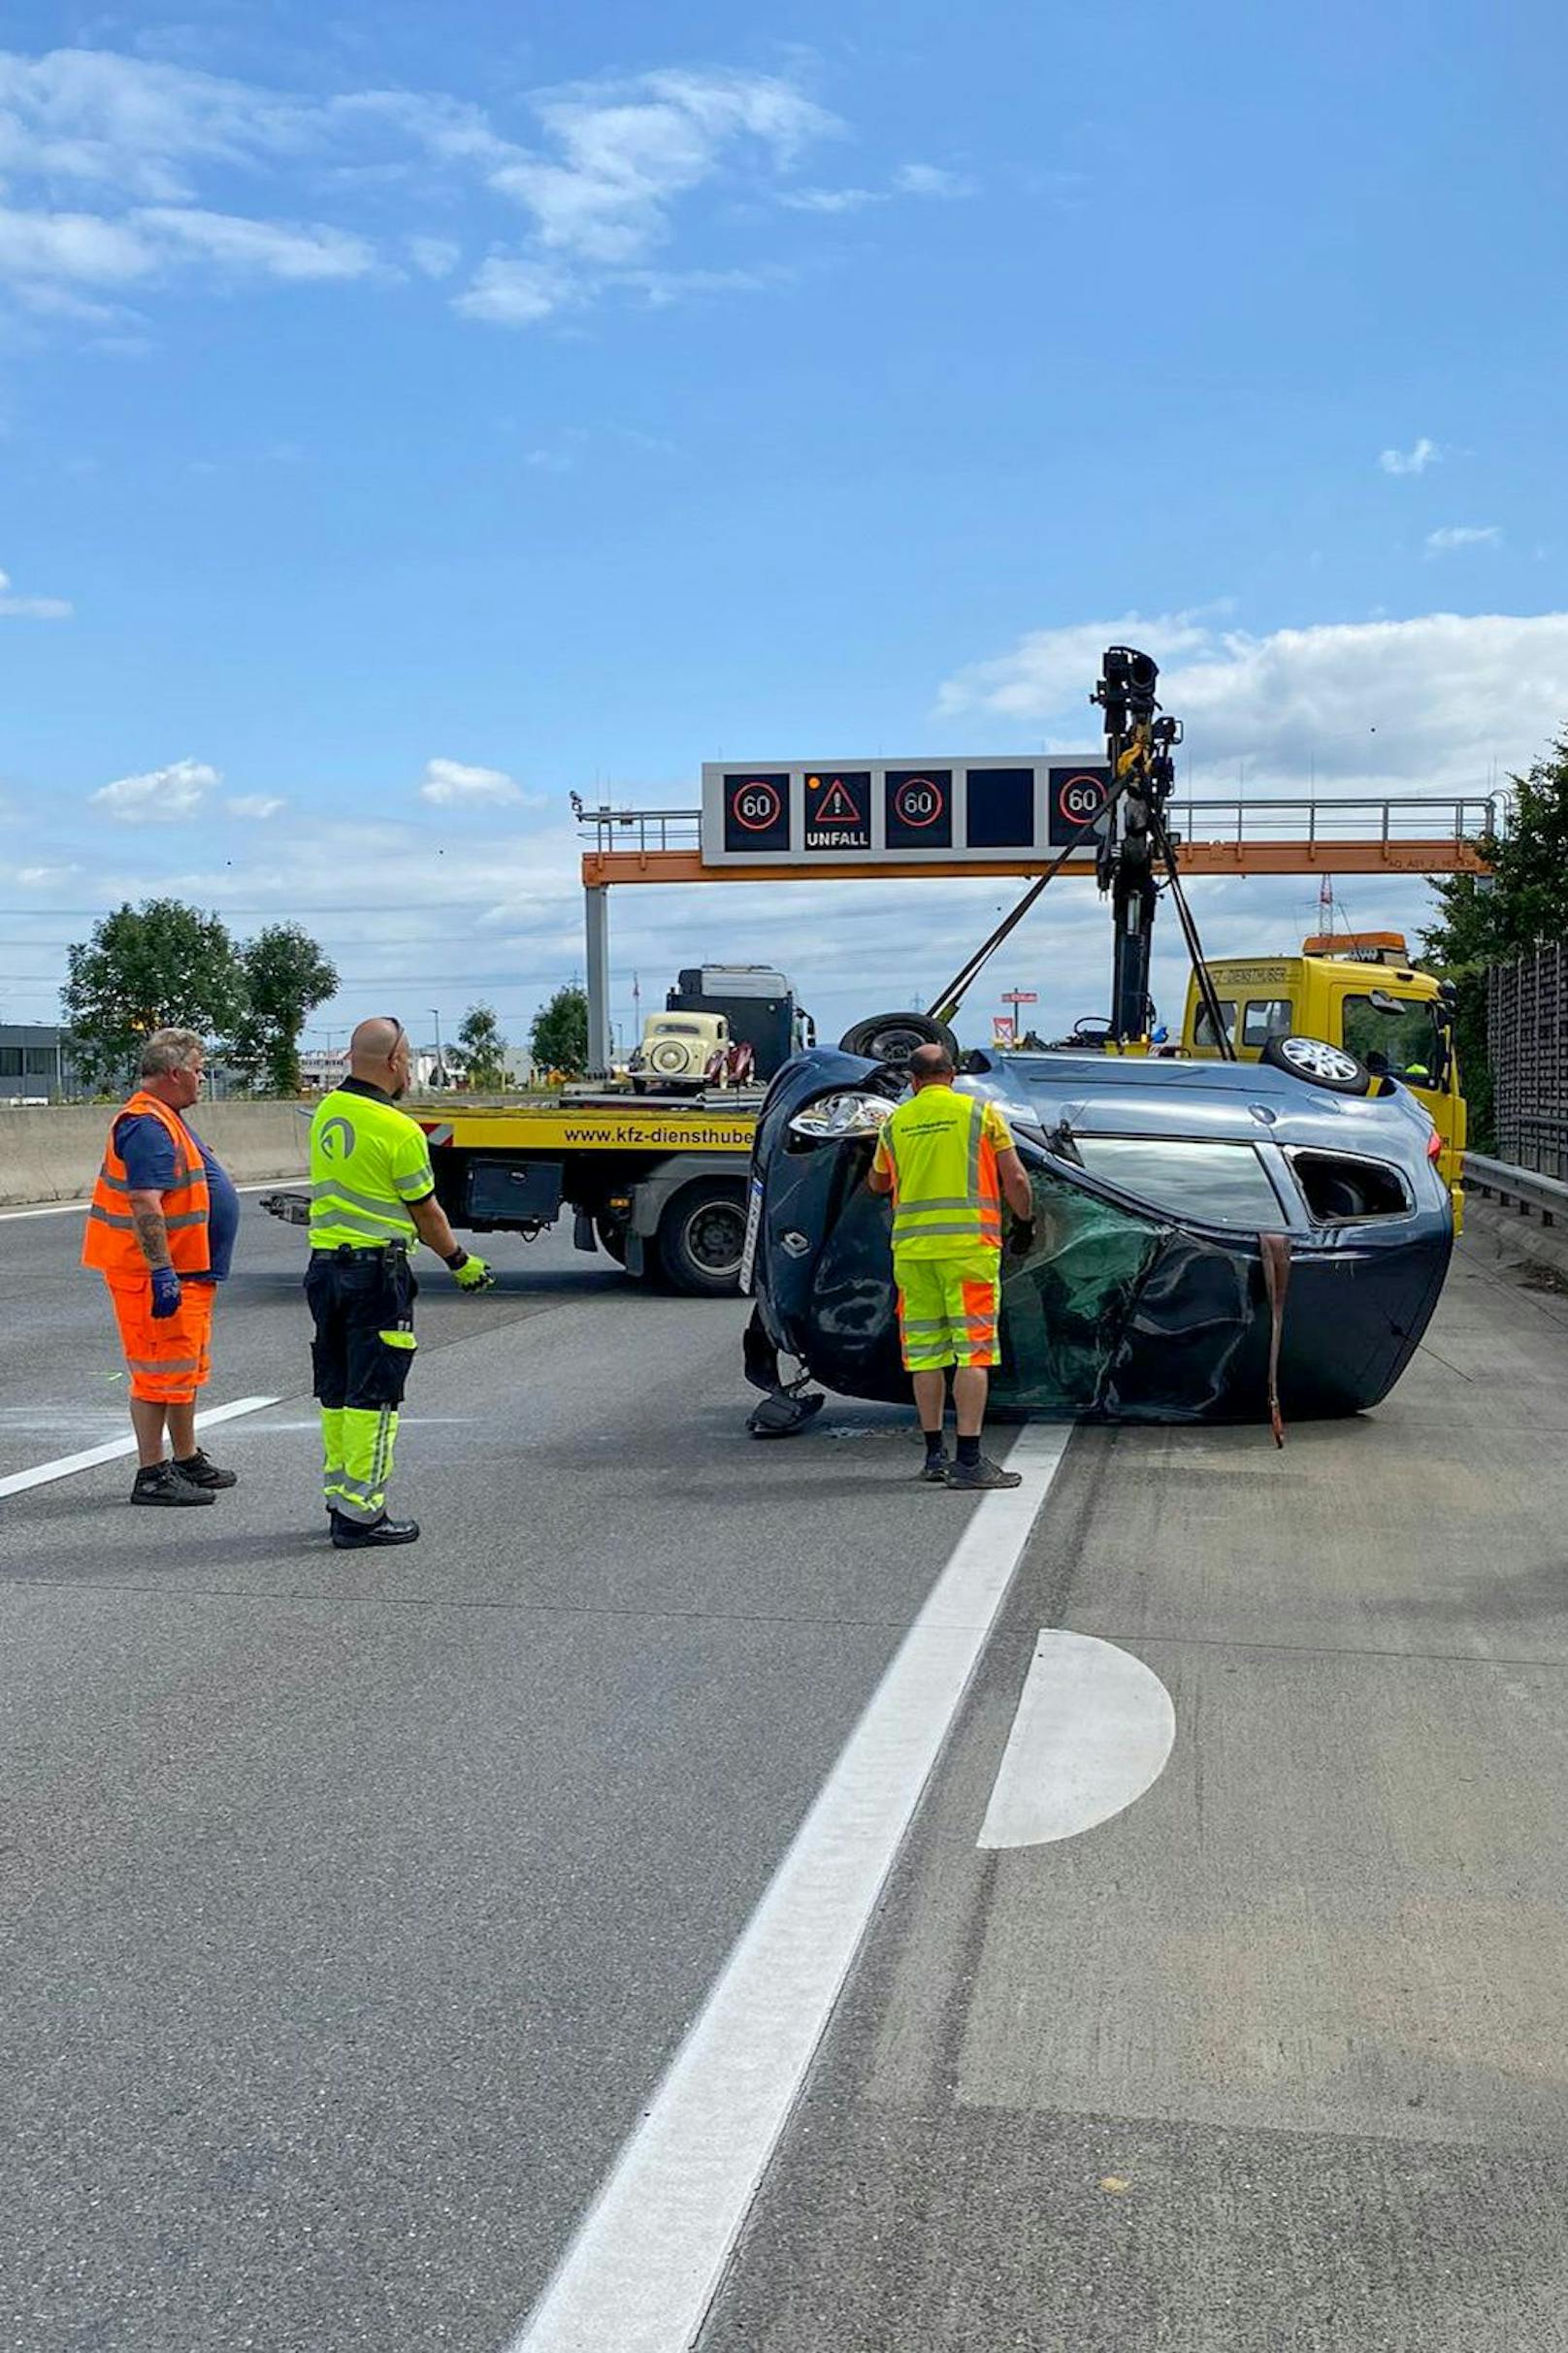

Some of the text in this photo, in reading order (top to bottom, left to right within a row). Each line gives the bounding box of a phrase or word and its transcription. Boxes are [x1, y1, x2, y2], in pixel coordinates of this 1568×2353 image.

[742, 795, 771, 817] 60
[903, 791, 932, 813] 60
[1068, 788, 1097, 811] 60
[806, 832, 868, 846] UNFALL
[564, 1127, 754, 1144] www.kfz-diensthube
